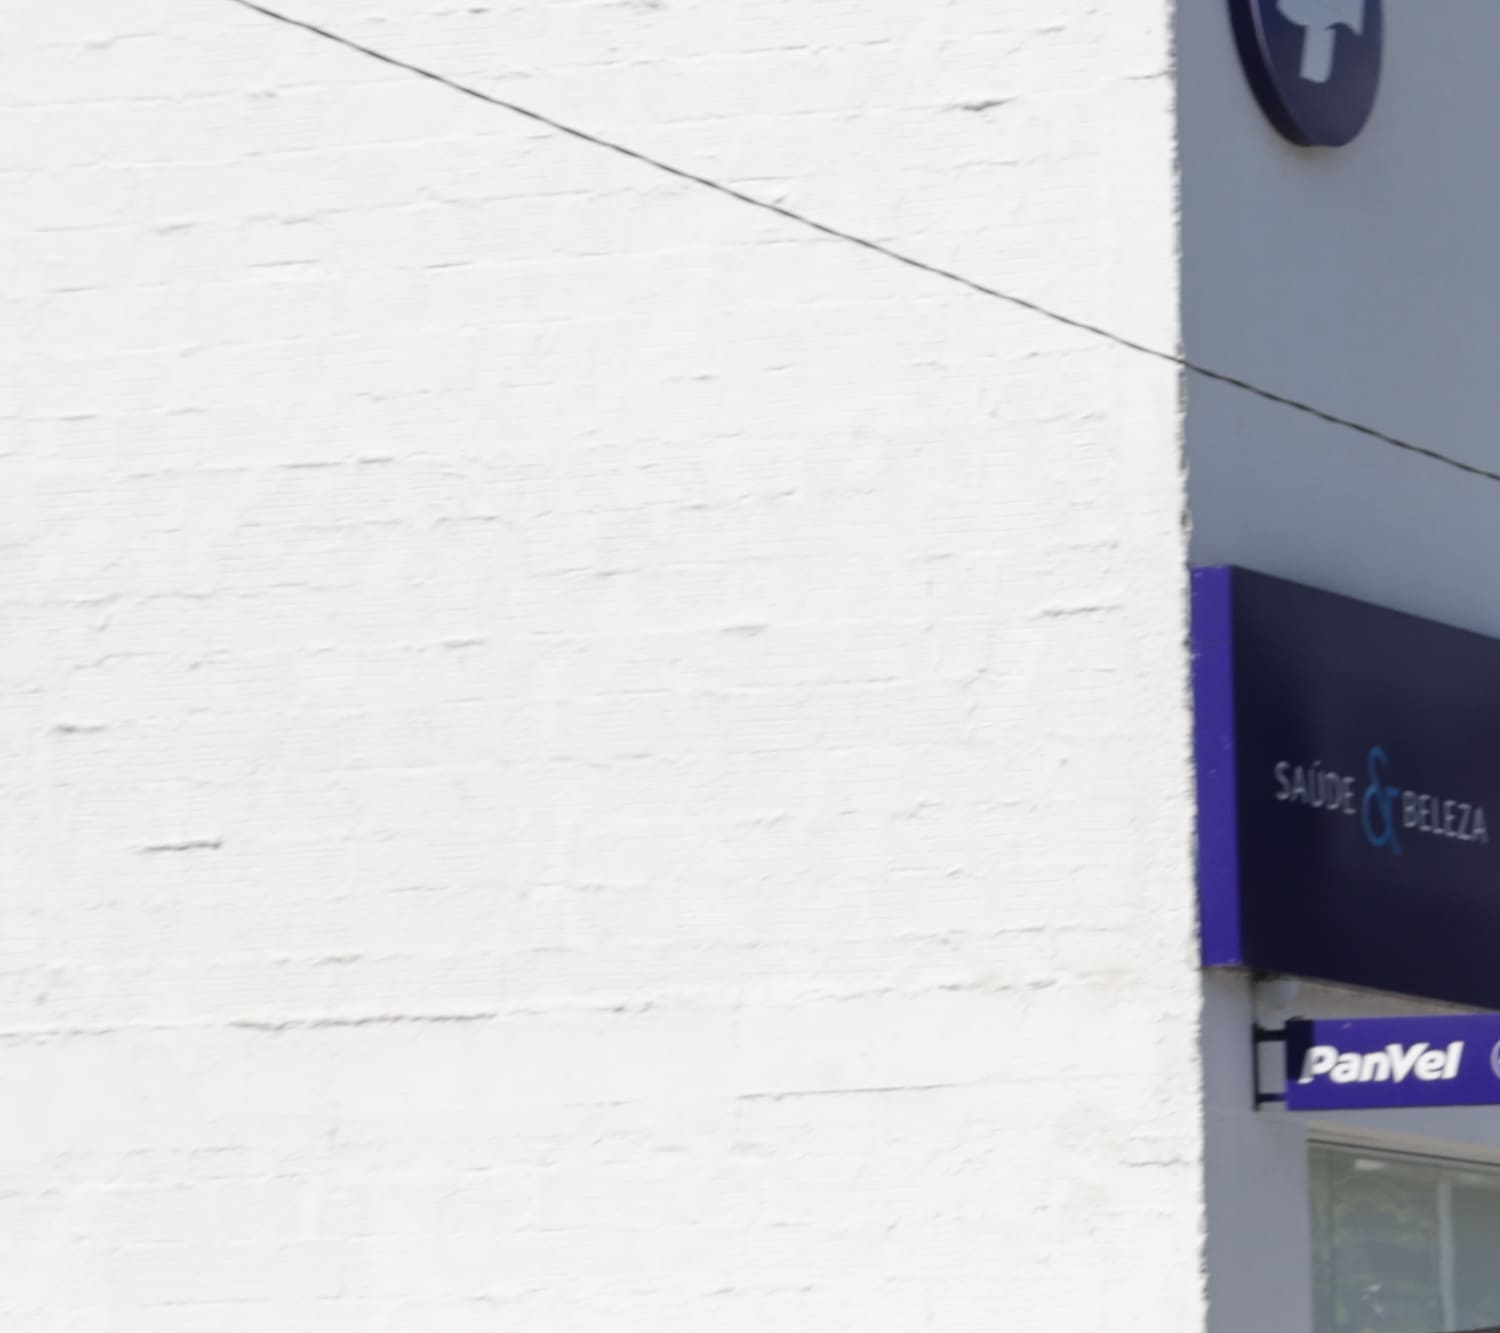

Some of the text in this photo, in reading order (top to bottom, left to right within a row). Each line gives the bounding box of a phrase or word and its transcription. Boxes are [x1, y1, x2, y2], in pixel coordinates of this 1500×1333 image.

[1274, 746, 1488, 855] SAÚDE & BELEZA
[1297, 1041, 1465, 1085] PanVel
